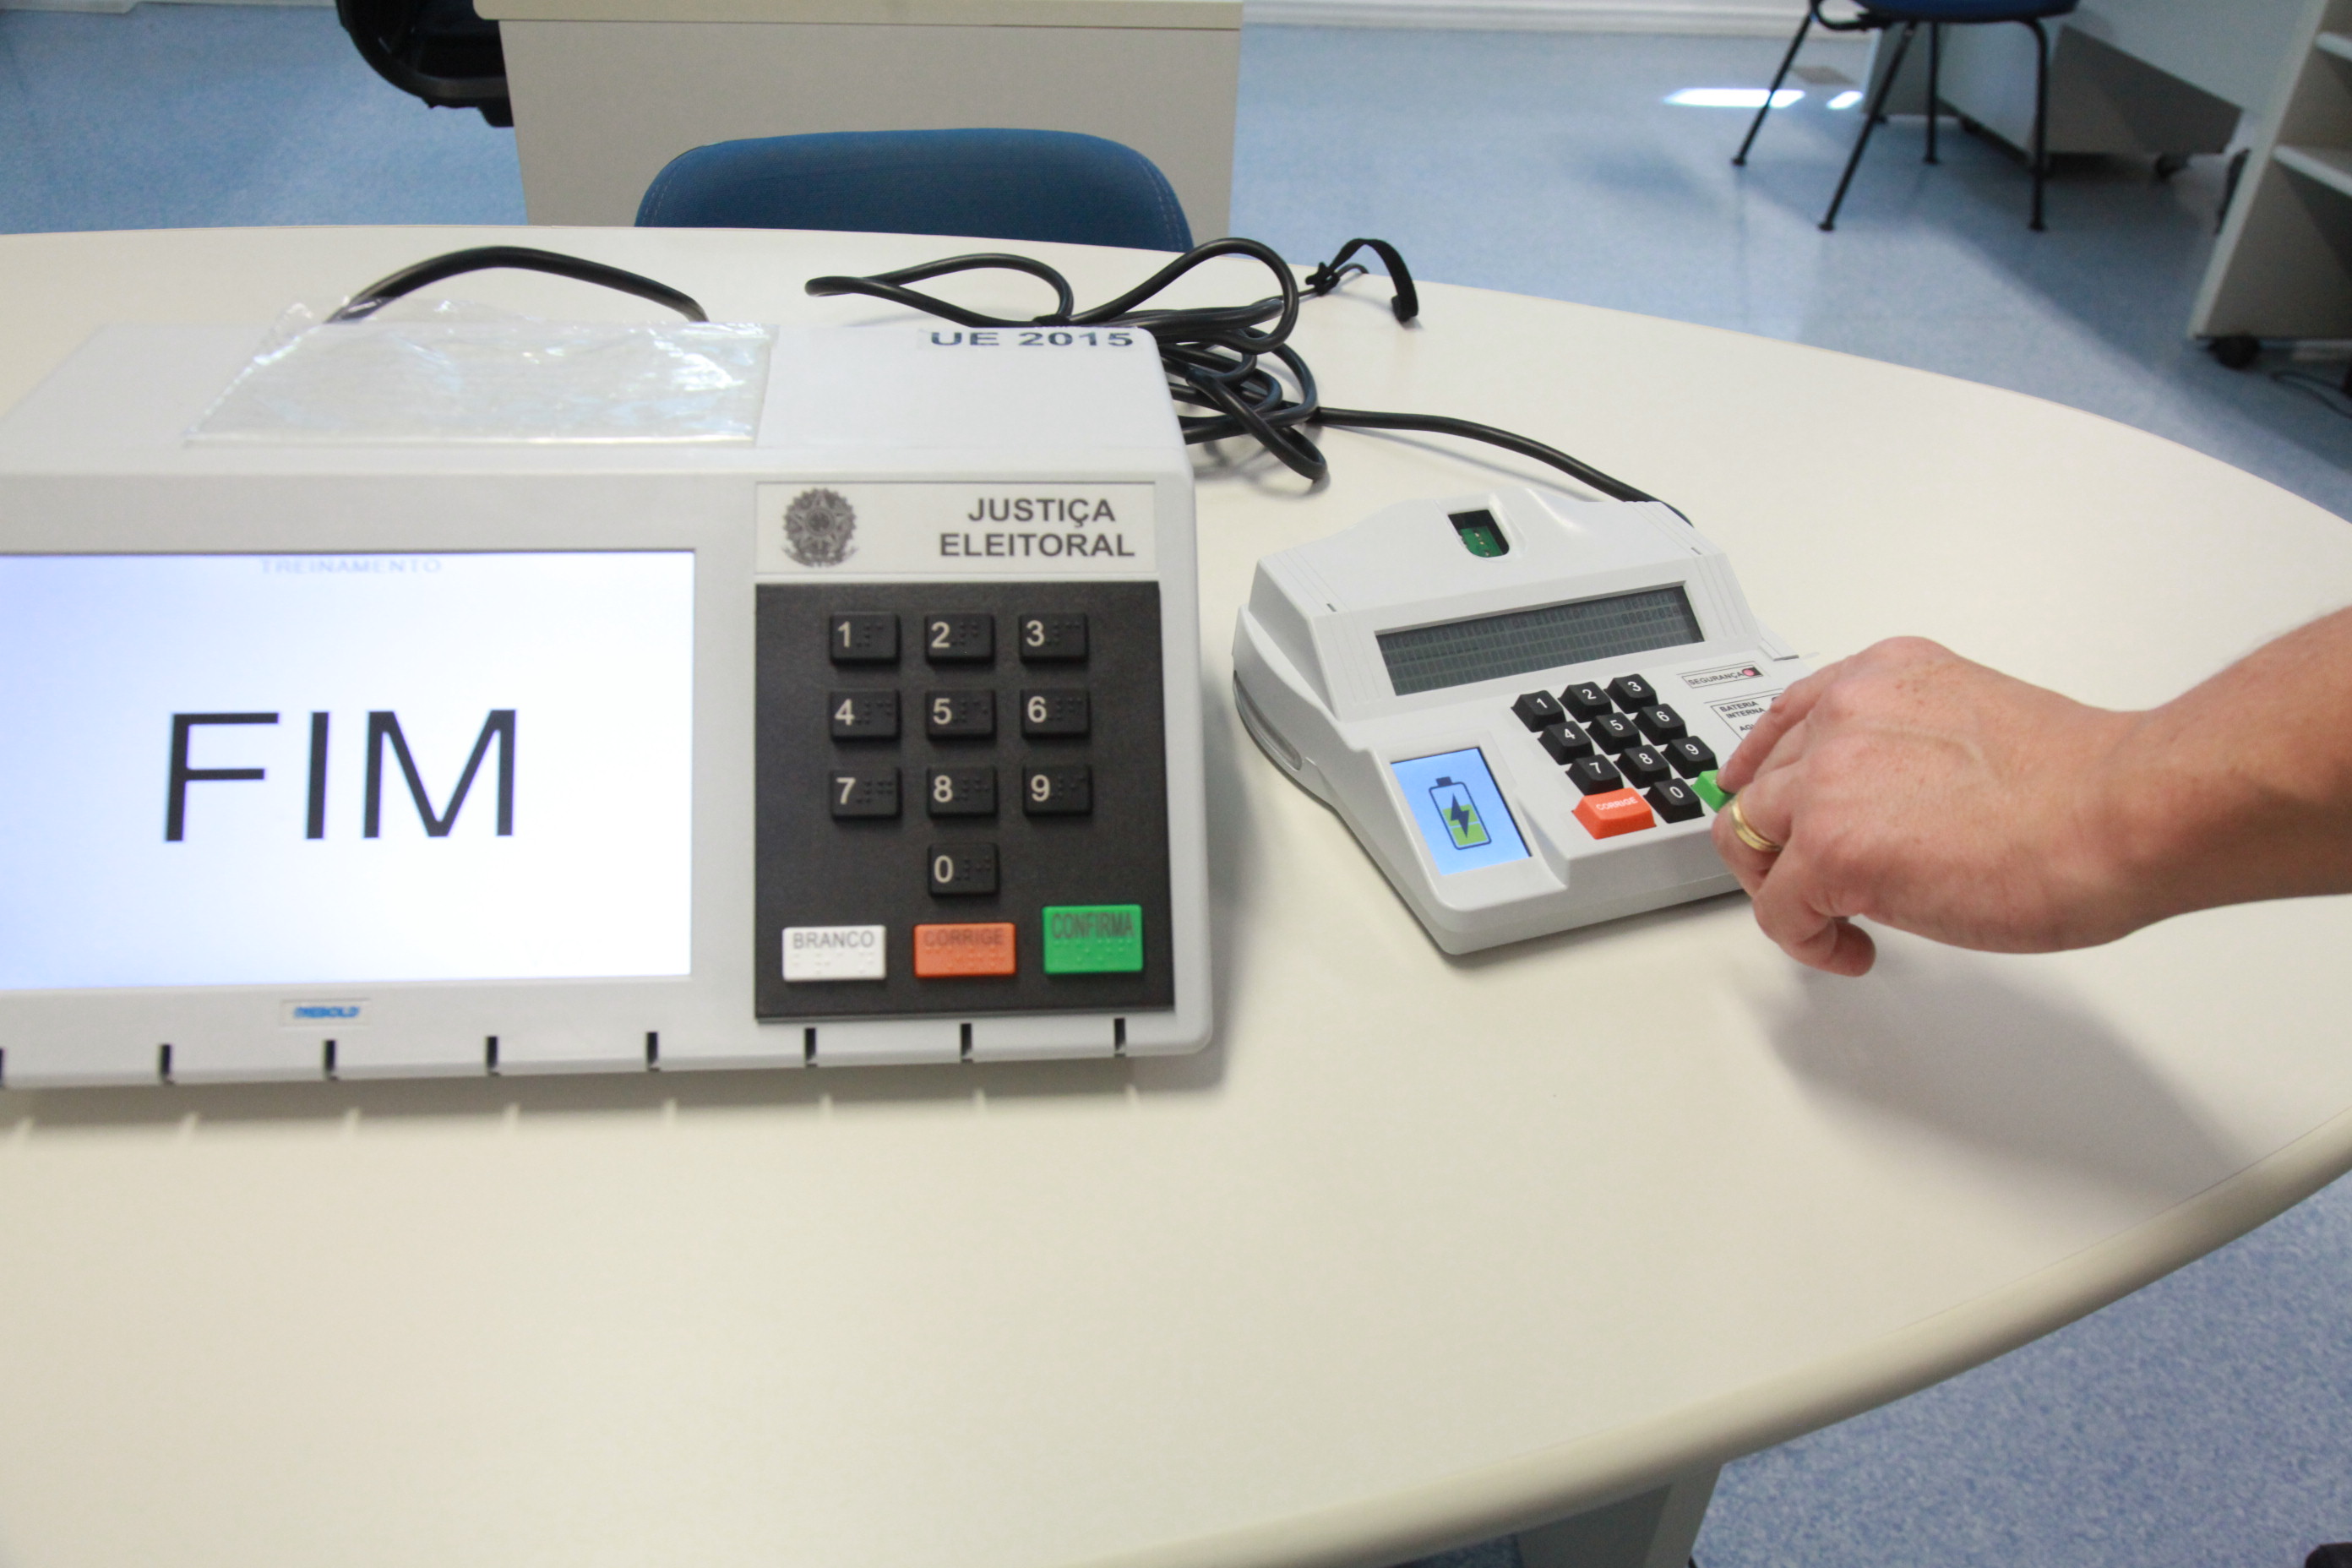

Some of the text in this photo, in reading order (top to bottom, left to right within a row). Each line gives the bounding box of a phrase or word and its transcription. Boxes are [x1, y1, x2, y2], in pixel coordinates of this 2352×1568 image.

[930, 332, 1134, 346] UE 2015
[967, 498, 1116, 528] JUSTIÇA
[939, 533, 1135, 558] ELEITORAL
[263, 558, 442, 574] TREINAMENTO
[837, 621, 851, 648] 1
[930, 622, 950, 648] 2
[1026, 621, 1045, 647] 3
[1627, 681, 1642, 692] 3
[1688, 672, 1745, 685] SEGURANÇA
[1537, 698, 1548, 709] 1
[1582, 689, 1596, 700] 2
[835, 700, 855, 725] 4
[933, 699, 952, 724] 5
[1027, 697, 1047, 722] 6
[1719, 701, 1760, 712] BATERIA
[1726, 707, 1766, 719] INTERNA
[1656, 710, 1669, 722] 6
[1564, 729, 1576, 741] 4
[1609, 720, 1624, 732] 5
[1685, 744, 1698, 755] 9
[1589, 762, 1602, 774] 7
[1639, 753, 1652, 765] 8
[165, 709, 517, 842] FIM
[837, 777, 856, 804] 7
[934, 776, 953, 803] 8
[1031, 775, 1050, 801] 9
[1669, 787, 1684, 798] 0
[1596, 797, 1638, 811] CORRIGE
[934, 856, 954, 882] 0
[1051, 912, 1135, 939] CONFIRMA
[792, 930, 874, 950] BRANCO
[923, 928, 1004, 948] CORRIGE
